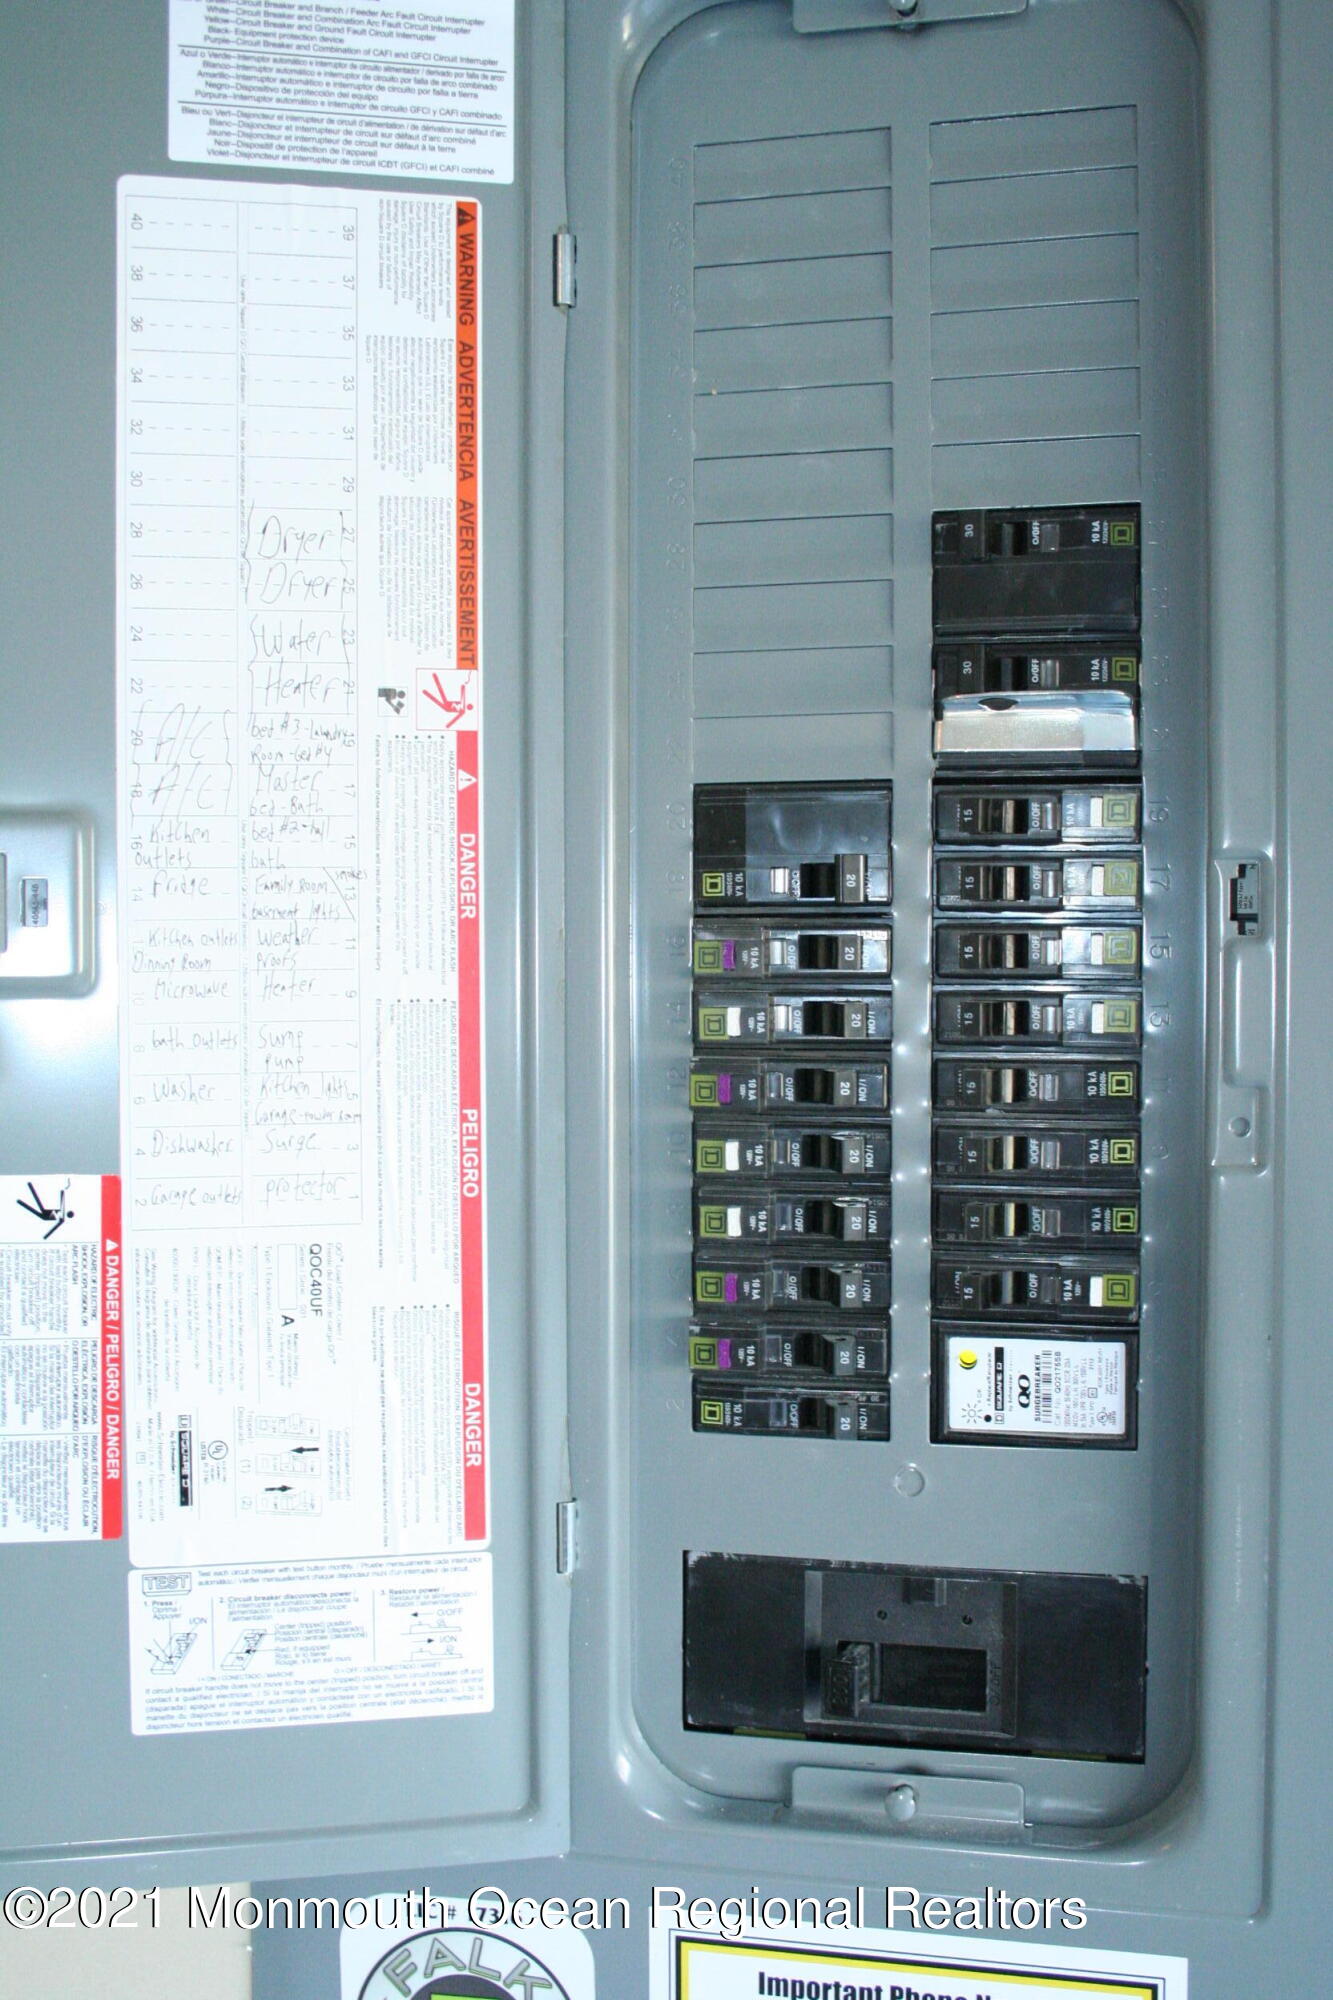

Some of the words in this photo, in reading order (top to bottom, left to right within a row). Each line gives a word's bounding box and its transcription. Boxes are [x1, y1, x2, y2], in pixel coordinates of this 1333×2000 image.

[298, 13, 312, 22] and
[315, 14, 364, 26] Combination
[382, 20, 400, 28] Fault
[404, 22, 429, 30] Circuit
[431, 25, 470, 34] Interrupter
[394, 51, 408, 59] and
[411, 52, 431, 60] GFCI
[433, 54, 458, 63] Circuit
[460, 56, 498, 66] Interrupter
[131, 213, 143, 230] 40
[342, 225, 354, 241] 39
[131, 265, 143, 281] 38
[459, 233, 474, 326] WARNING
[342, 275, 354, 290] 37
[131, 316, 143, 332] 36
[342, 325, 354, 341] 35
[131, 368, 143, 384] 34
[342, 376, 354, 392] 33
[459, 340, 474, 482] ADVERTENCIA
[130, 418, 142, 435] 32
[342, 426, 354, 441] 31
[130, 471, 142, 488] 30
[342, 477, 354, 494] 29
[130, 522, 142, 538] 28
[965, 524, 974, 538] 30
[1032, 520, 1040, 545] O/OFF
[1092, 520, 1100, 531] kA
[258, 515, 336, 564] Dryer
[1092, 532, 1100, 543] 10
[130, 574, 142, 590] 26
[260, 562, 337, 604] Dryer
[460, 498, 476, 665] AVERTISSEMENT
[130, 626, 142, 642] 24
[261, 618, 332, 661] Water
[963, 661, 972, 675] 30
[1032, 659, 1040, 683] O/OFF
[1091, 659, 1100, 670] kA
[266, 658, 341, 708] Heater
[1091, 670, 1100, 681] 10
[130, 678, 143, 694] 22
[964, 809, 972, 821] 15
[1032, 802, 1040, 827] O/OFF
[459, 832, 477, 919] DANGER
[735, 872, 744, 884] 10
[847, 874, 856, 887] 20
[965, 876, 974, 889] 15
[735, 886, 744, 897] kA
[845, 946, 854, 960] 20
[964, 946, 973, 958] 15
[1032, 935, 1040, 958] O/OFF
[787, 946, 796, 969] O/OFF
[155, 978, 231, 1000] Microwave
[794, 1010, 802, 1034] O/OFF
[851, 1014, 860, 1027] 20
[964, 1012, 973, 1024] 15
[1032, 1005, 1041, 1029] O/OFF
[1088, 1071, 1096, 1082] kA
[152, 1078, 215, 1106] Washer
[785, 1077, 794, 1101] O/OFF
[840, 1082, 850, 1095] 20
[967, 1081, 976, 1094] 15
[1088, 1085, 1096, 1096] 10
[152, 1129, 233, 1158] Dishwasher
[1090, 1139, 1099, 1150] kA
[461, 1108, 479, 1198] PELIGRO
[792, 1143, 800, 1167] O/OFF
[849, 1150, 859, 1163] 20
[968, 1150, 977, 1162] 15
[1090, 1153, 1099, 1164] 10
[795, 1208, 804, 1232] O/OFF
[1091, 1208, 1100, 1218] kA
[852, 1217, 862, 1230] 20
[970, 1216, 979, 1228] 15
[1091, 1221, 1100, 1232] 10
[90, 1244, 98, 1273] HAZARD
[90, 1276, 98, 1284] OF
[309, 1243, 322, 1316] QOC40UF
[1029, 1273, 1038, 1298] O/OFF
[1063, 1279, 1073, 1289] kA
[105, 1255, 119, 1321] DANGER
[846, 1285, 855, 1298] 20
[964, 1287, 973, 1299] 15
[1063, 1290, 1073, 1300] 10
[90, 1286, 98, 1320] ELECTRIC
[281, 1315, 294, 1327] A
[783, 1344, 792, 1368] O/OFF
[840, 1351, 850, 1365] 20
[106, 1334, 120, 1402] PELIGRO
[1018, 1374, 1030, 1408] QO
[464, 1382, 482, 1468] DANGER
[840, 1417, 850, 1431] 20
[106, 1414, 120, 1479] DANGER
[144, 1575, 190, 1591] TEST
[758, 1971, 883, 2000] Important
